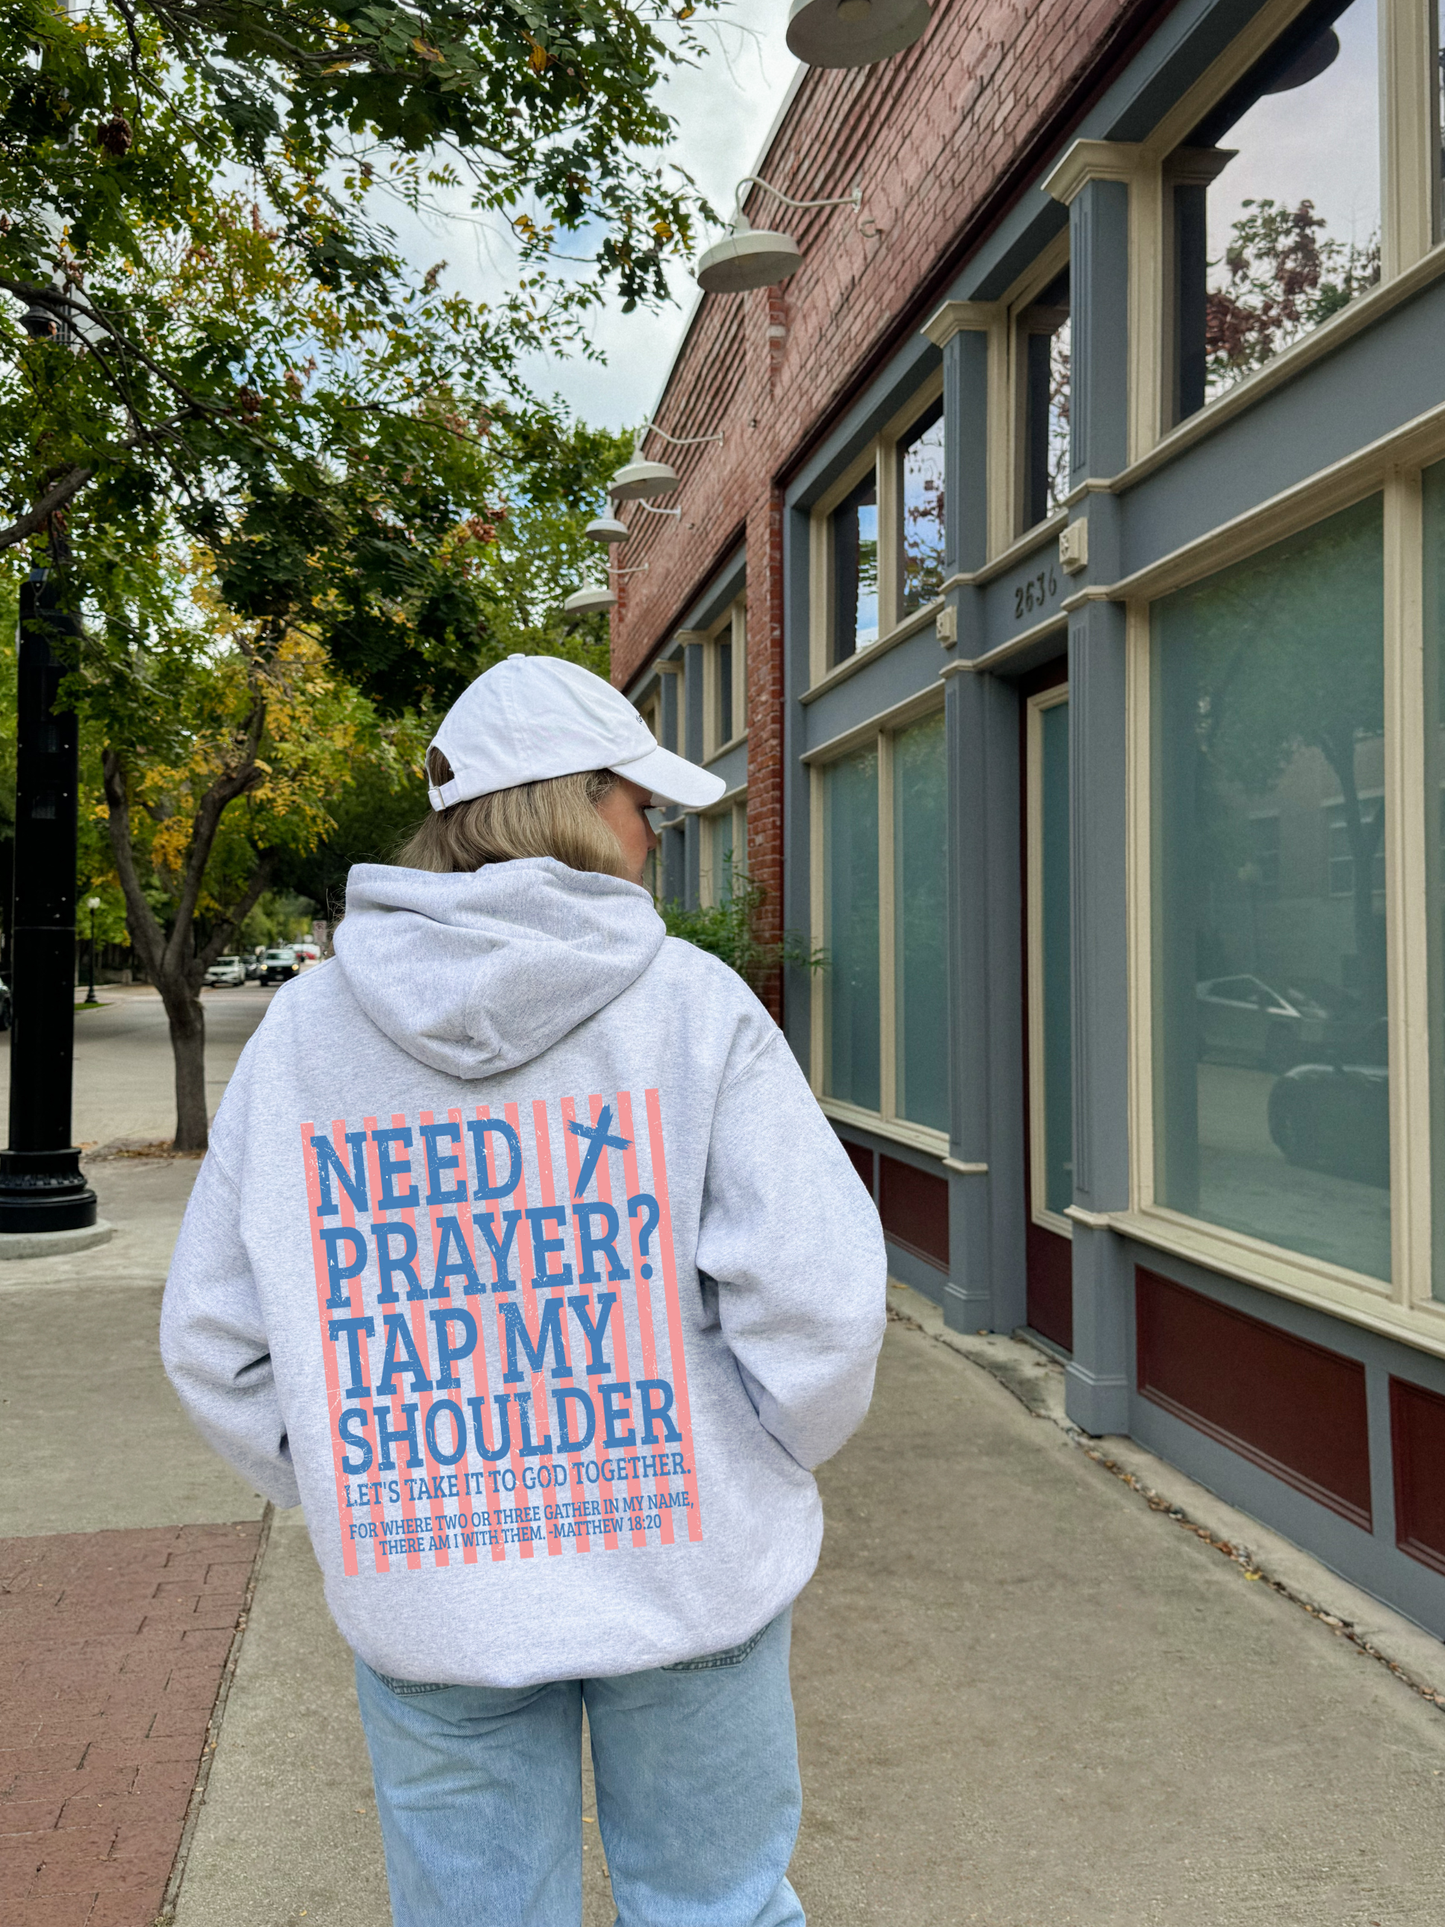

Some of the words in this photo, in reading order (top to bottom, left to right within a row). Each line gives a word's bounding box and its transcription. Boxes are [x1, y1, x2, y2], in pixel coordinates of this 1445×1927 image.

[311, 1117, 522, 1216] NEED
[319, 1193, 660, 1309] PRAYER?
[327, 1307, 478, 1399] TAP
[498, 1291, 617, 1384] MY
[338, 1378, 682, 1476] SHOULDER
[344, 1480, 401, 1508] LET'S
[404, 1474, 460, 1502] TAKE
[463, 1471, 484, 1496] IT
[487, 1468, 517, 1493] TO
[521, 1463, 568, 1490] GOD
[571, 1451, 692, 1485] TOGETHER.
[348, 1522, 379, 1540] FOR
[379, 1516, 433, 1536] WHERE
[434, 1513, 468, 1531] TWO
[471, 1511, 492, 1527] OR
[493, 1505, 541, 1525] THREE
[543, 1500, 602, 1520] GATHER
[603, 1497, 620, 1515] IN
[622, 1495, 645, 1513] MY
[647, 1490, 694, 1510] NAME,
[378, 1536, 426, 1556] THERE
[428, 1534, 452, 1551] AM
[453, 1533, 460, 1549] I
[460, 1529, 499, 1548] WITH
[501, 1525, 546, 1544] THEM.
[548, 1516, 624, 1539] -MATTHEW
[626, 1513, 662, 1532] 18:20
